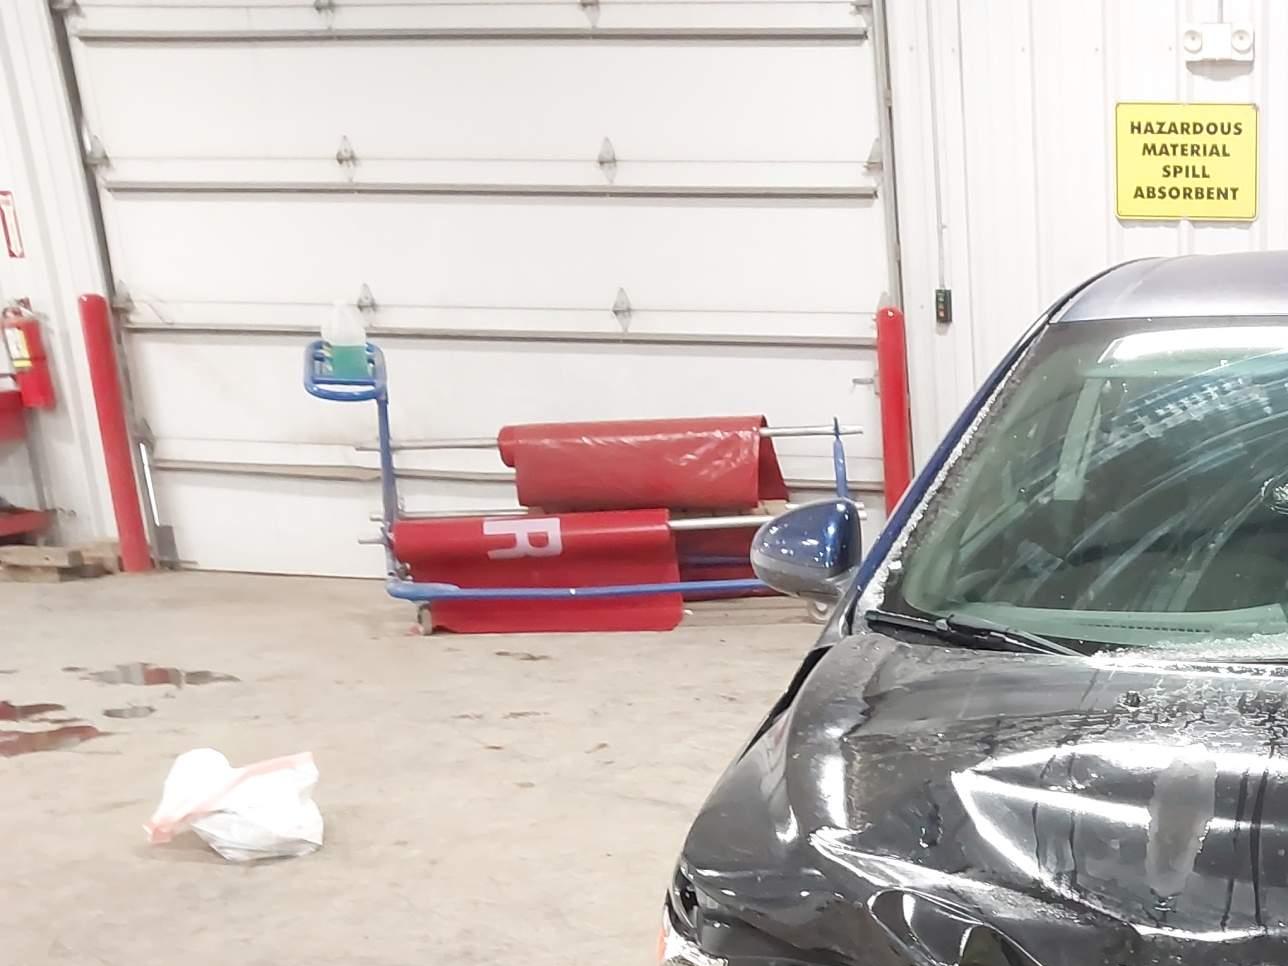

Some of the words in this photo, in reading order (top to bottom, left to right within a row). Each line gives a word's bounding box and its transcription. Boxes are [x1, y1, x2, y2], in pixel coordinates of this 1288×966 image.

[1130, 121, 1243, 135] HAZARDOUS
[1141, 143, 1231, 157] MATERIAL
[1161, 165, 1210, 178] SPILL
[1133, 186, 1239, 200] ABSORBENT
